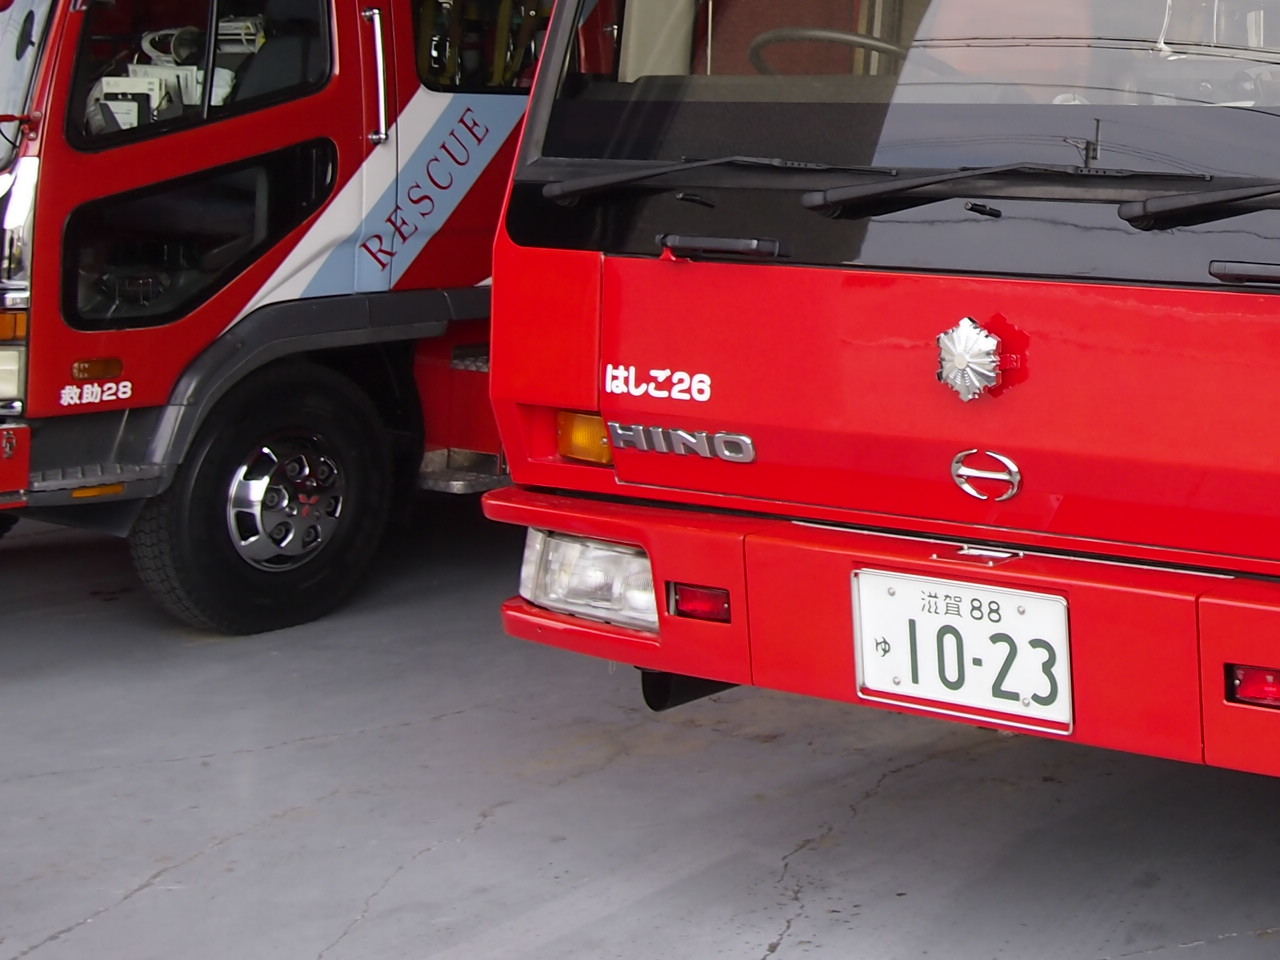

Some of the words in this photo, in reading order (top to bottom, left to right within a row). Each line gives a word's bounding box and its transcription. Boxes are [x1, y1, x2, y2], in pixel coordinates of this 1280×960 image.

[359, 106, 490, 272] RESCUE
[60, 380, 133, 406] 救助28
[605, 363, 712, 402] はしご26
[607, 421, 757, 463] HINO
[908, 618, 1059, 707] 10-23
